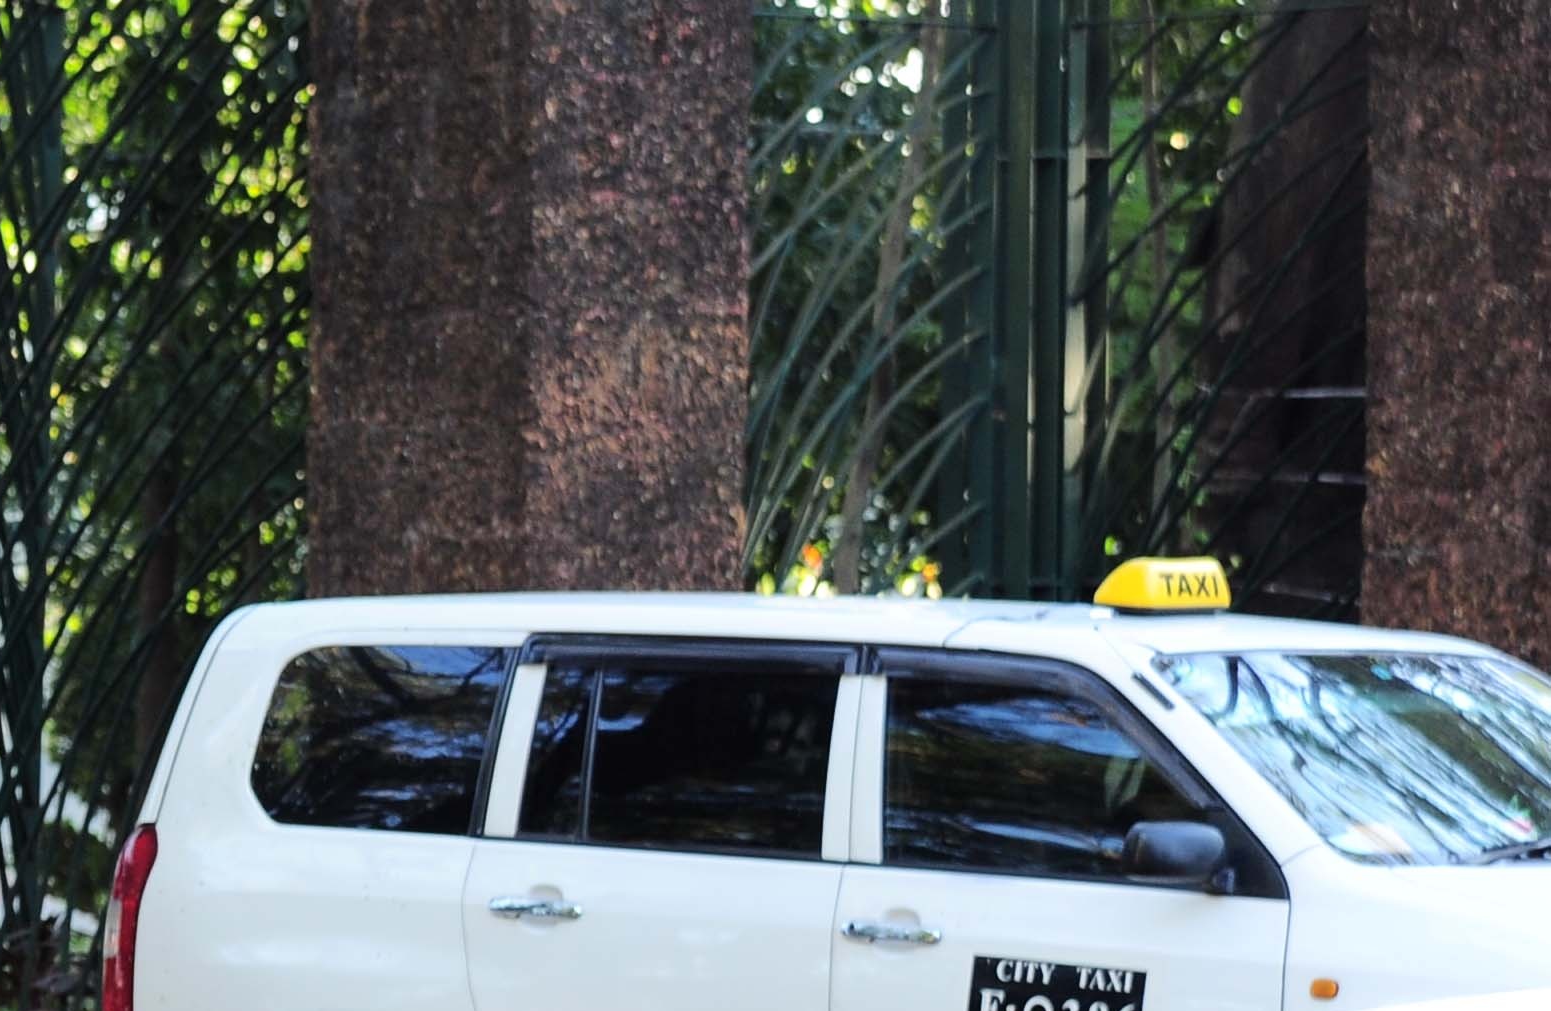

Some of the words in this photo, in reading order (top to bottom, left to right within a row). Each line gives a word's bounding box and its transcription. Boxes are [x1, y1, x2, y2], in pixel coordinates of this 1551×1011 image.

[1159, 573, 1219, 598] TAXI
[996, 959, 1055, 986] CITY
[1076, 967, 1134, 994] TAXI
